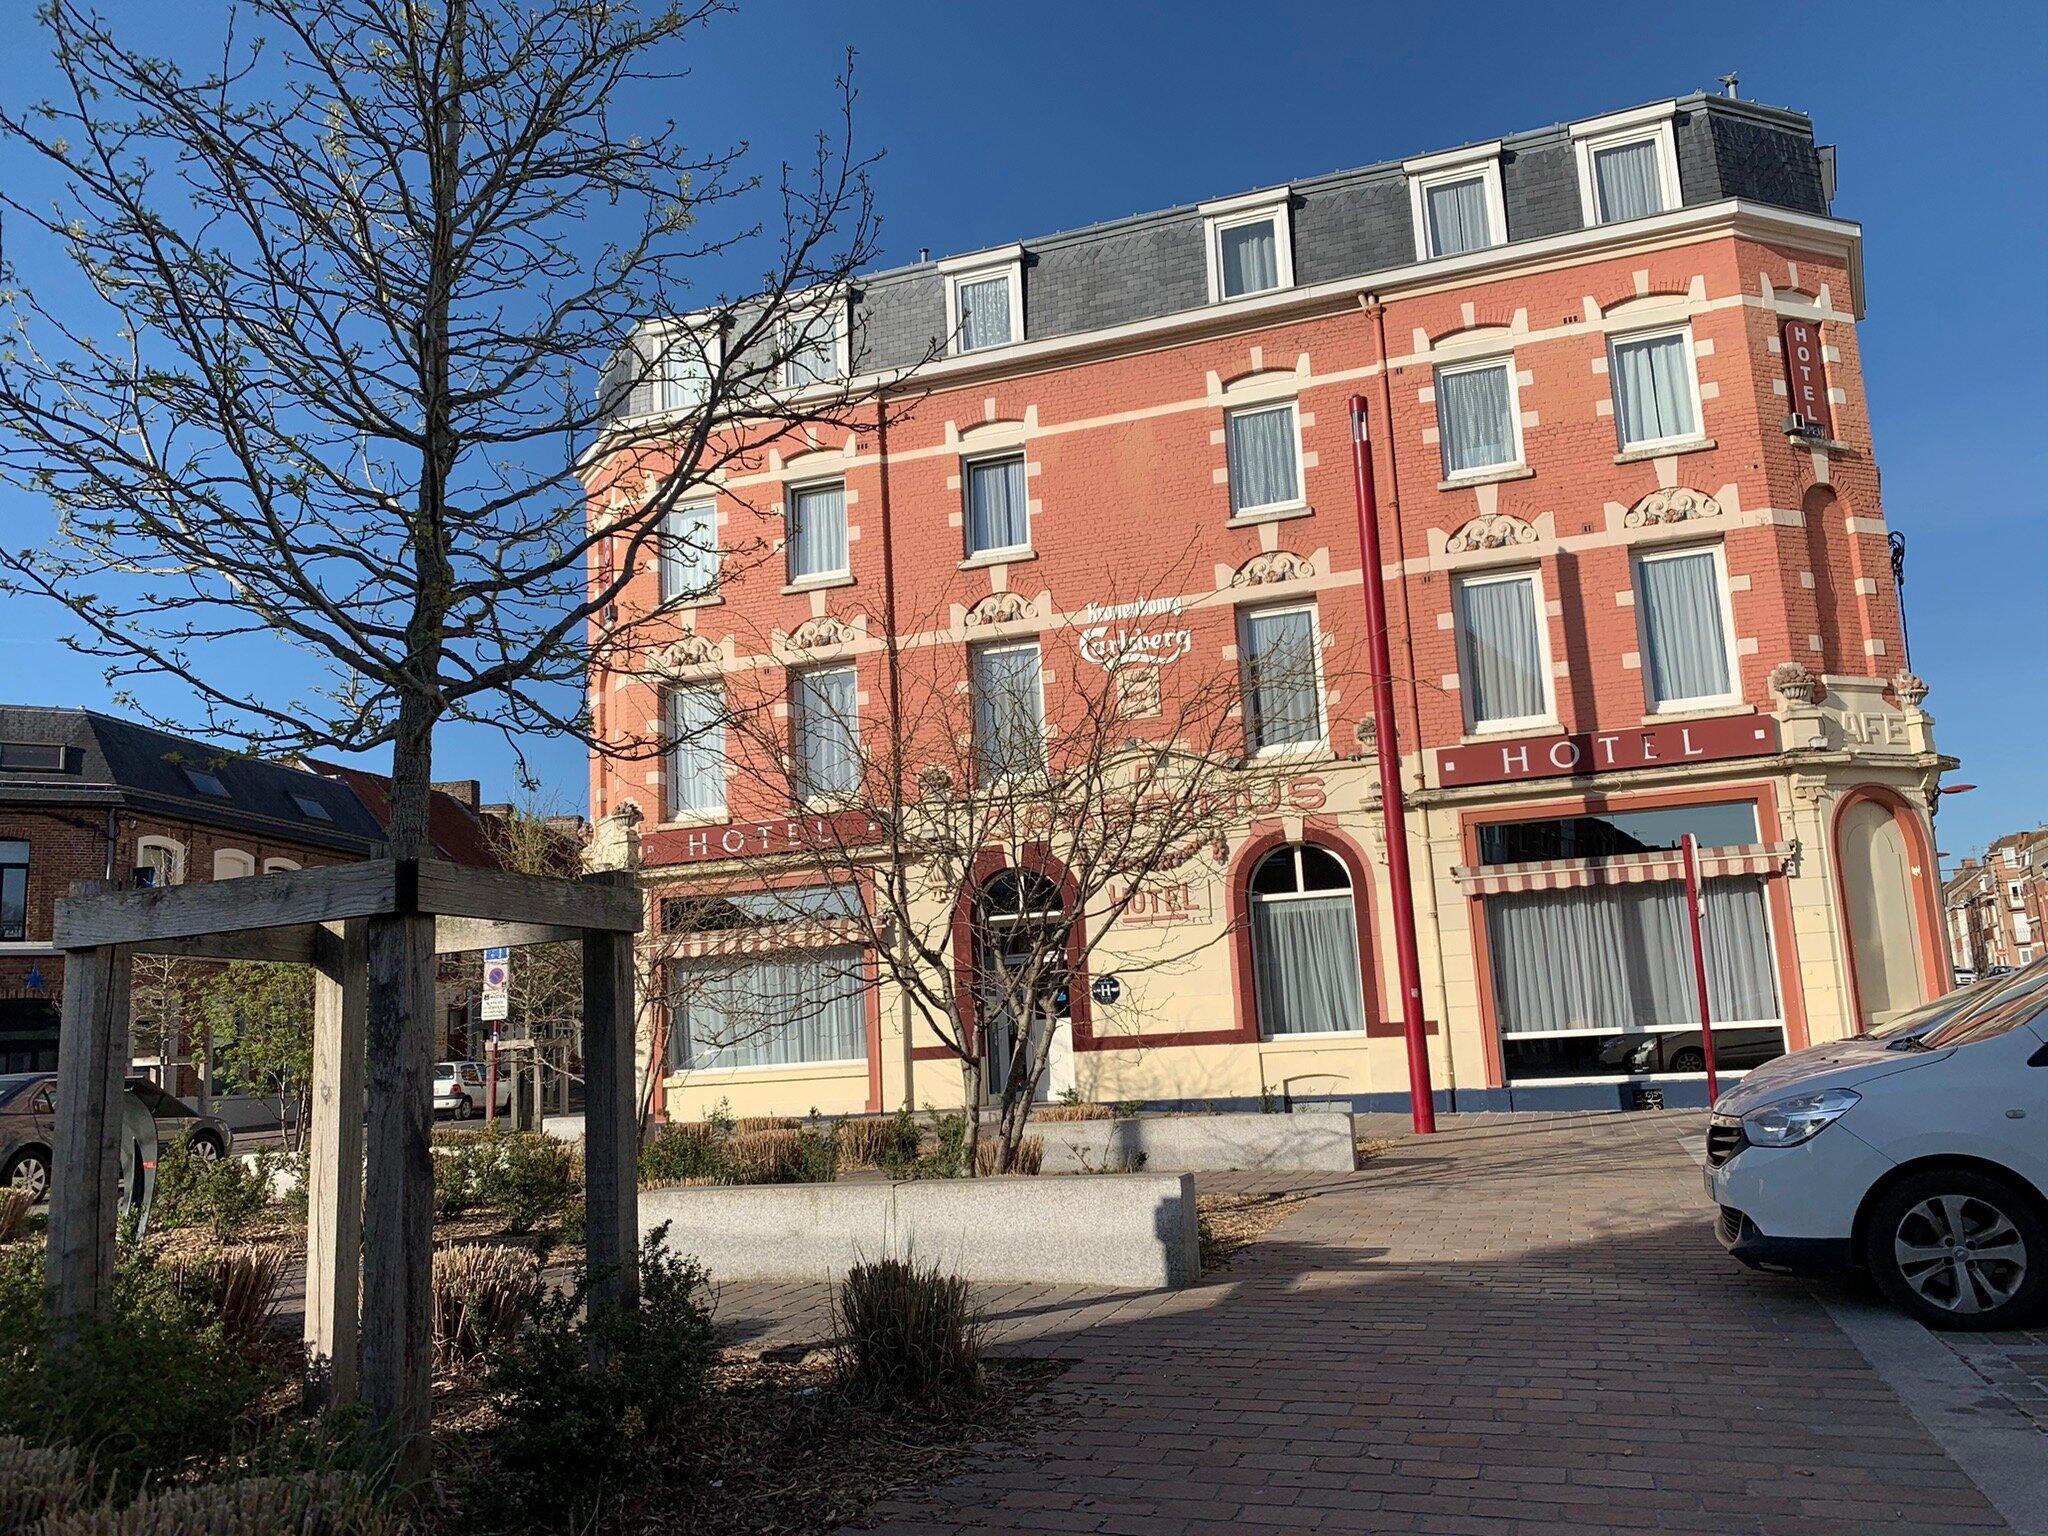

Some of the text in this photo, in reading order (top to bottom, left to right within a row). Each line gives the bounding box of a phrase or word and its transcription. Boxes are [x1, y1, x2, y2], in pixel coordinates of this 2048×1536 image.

[1794, 326, 1818, 421] HOTEL
[1079, 627, 1192, 672] Carlsberg
[1501, 728, 1704, 774] HOTEL
[688, 821, 832, 857] HOTEL
[1108, 882, 1200, 916] HOTEL
